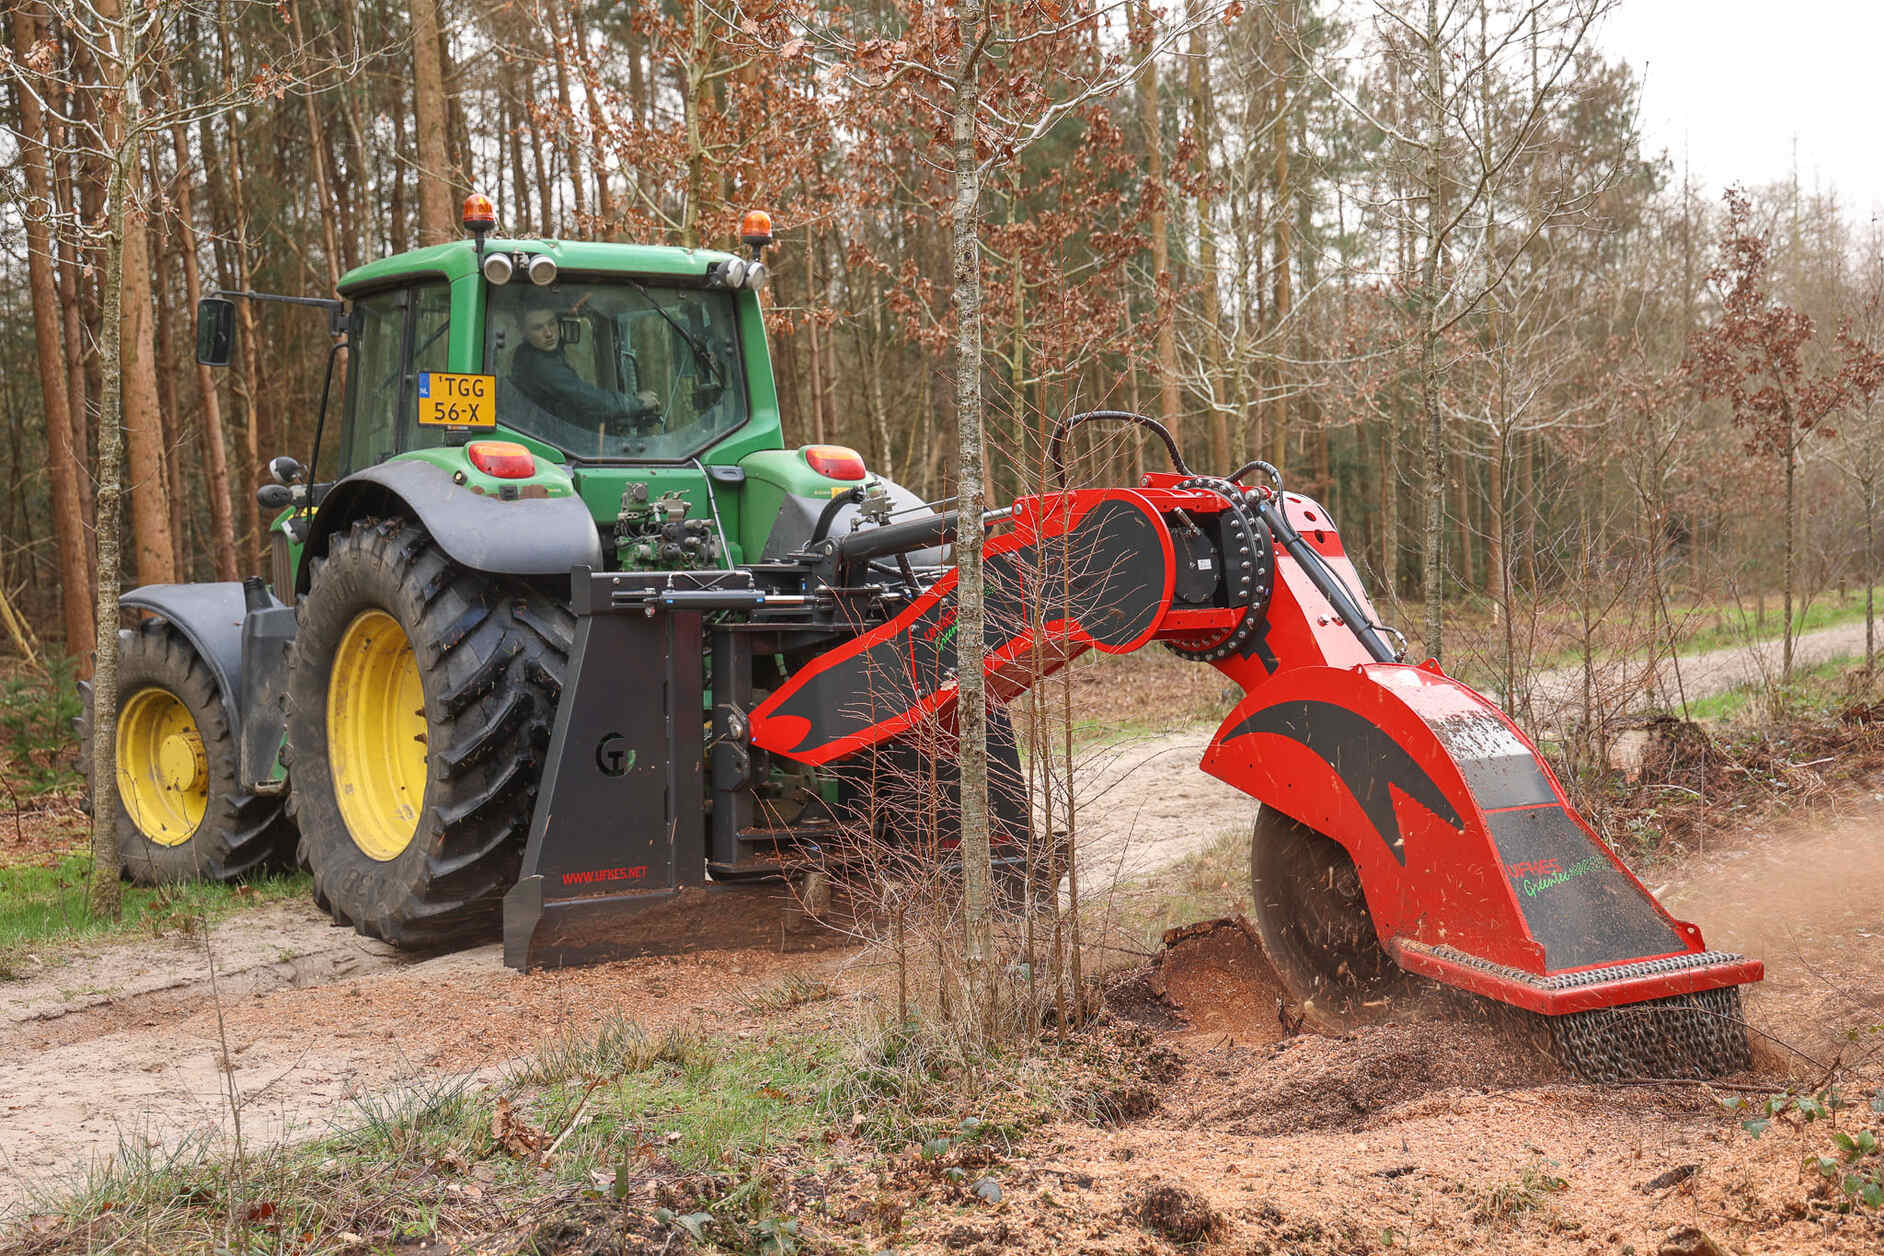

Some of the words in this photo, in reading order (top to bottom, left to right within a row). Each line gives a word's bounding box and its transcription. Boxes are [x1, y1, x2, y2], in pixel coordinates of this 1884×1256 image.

[445, 377, 484, 397] TGG
[434, 402, 480, 422] 56-X
[562, 865, 649, 886] WWW.UFKES.NET
